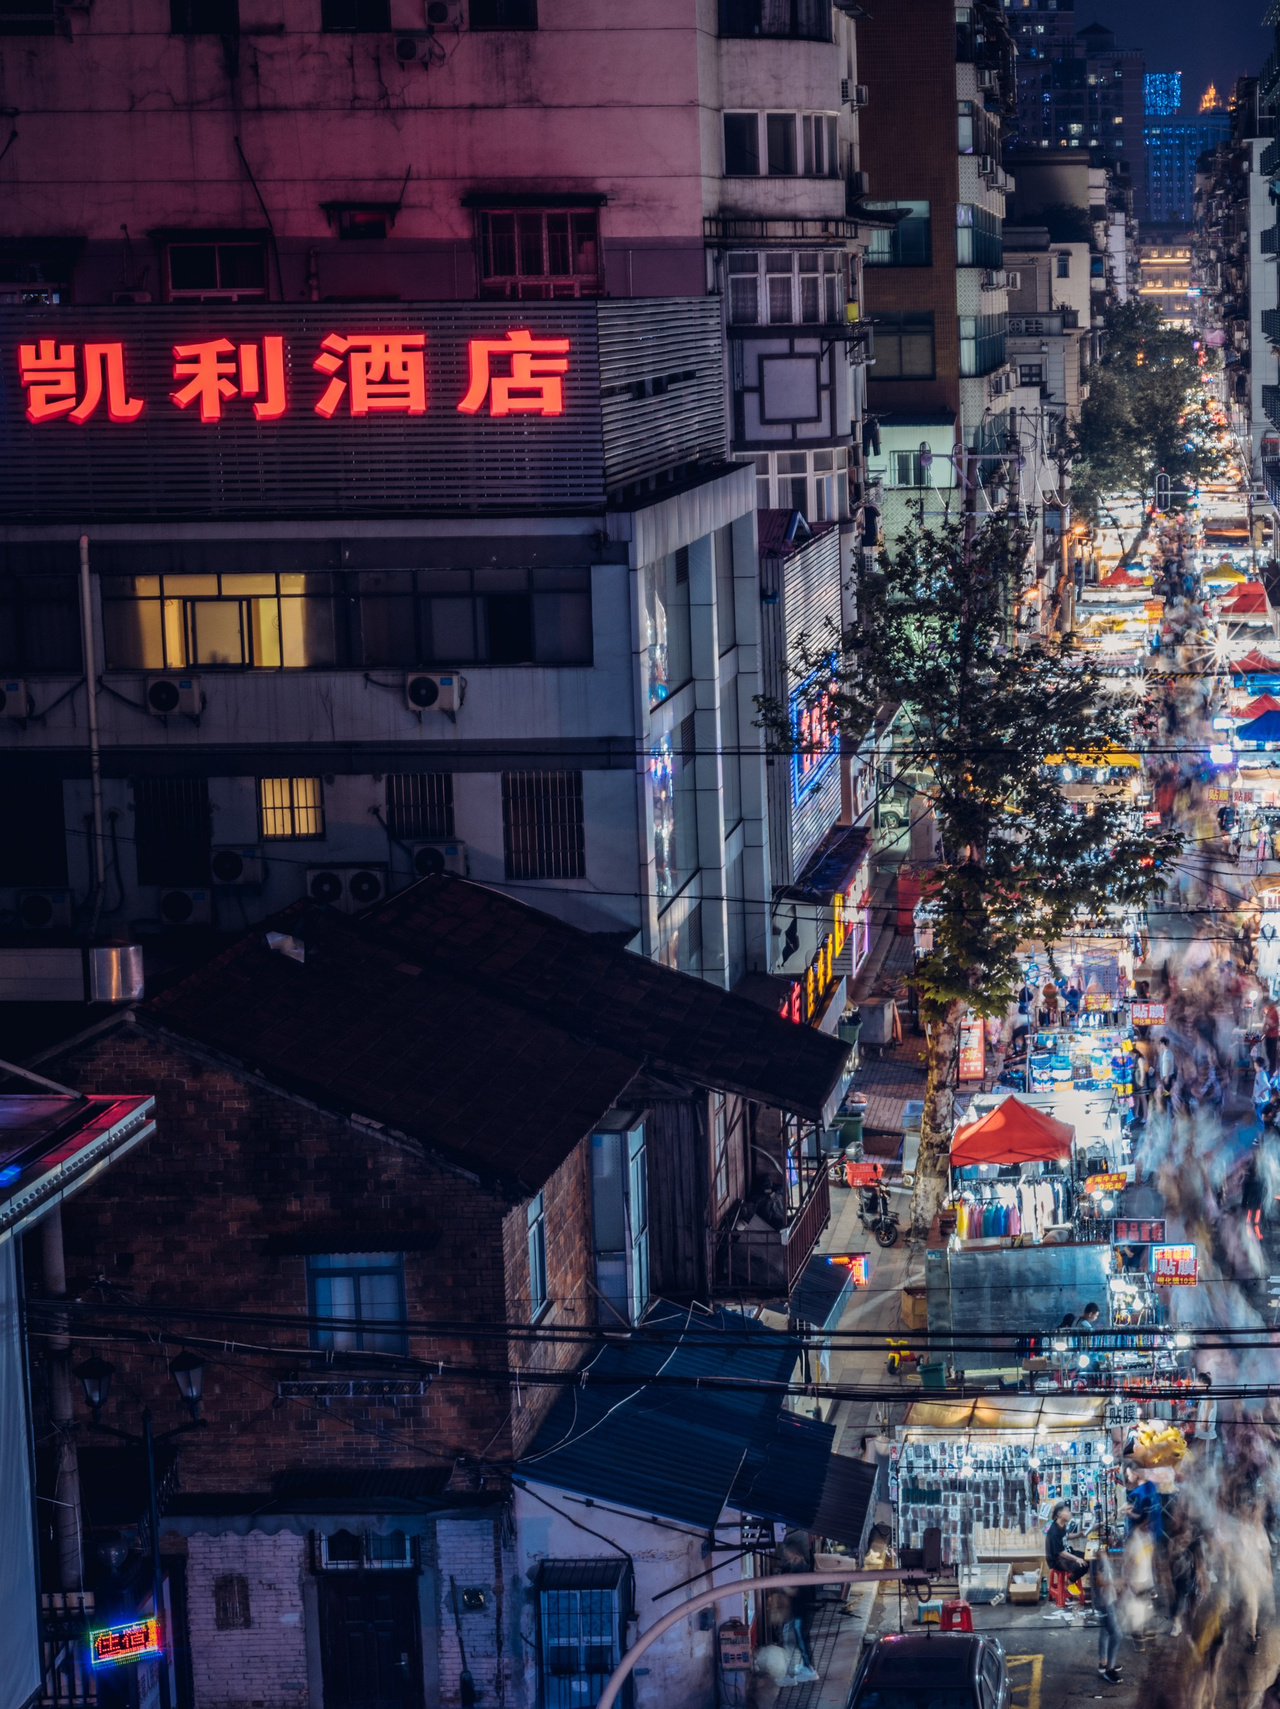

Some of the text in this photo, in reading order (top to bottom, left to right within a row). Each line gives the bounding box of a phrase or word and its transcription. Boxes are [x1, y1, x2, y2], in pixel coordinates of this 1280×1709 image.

[18, 331, 571, 425] 凯利酒店
[1132, 1004, 1164, 1018] 贴膜
[1159, 1259, 1195, 1275] 贴膜
[1109, 1404, 1135, 1425] 贴膜
[94, 1624, 147, 1654] 住宿
